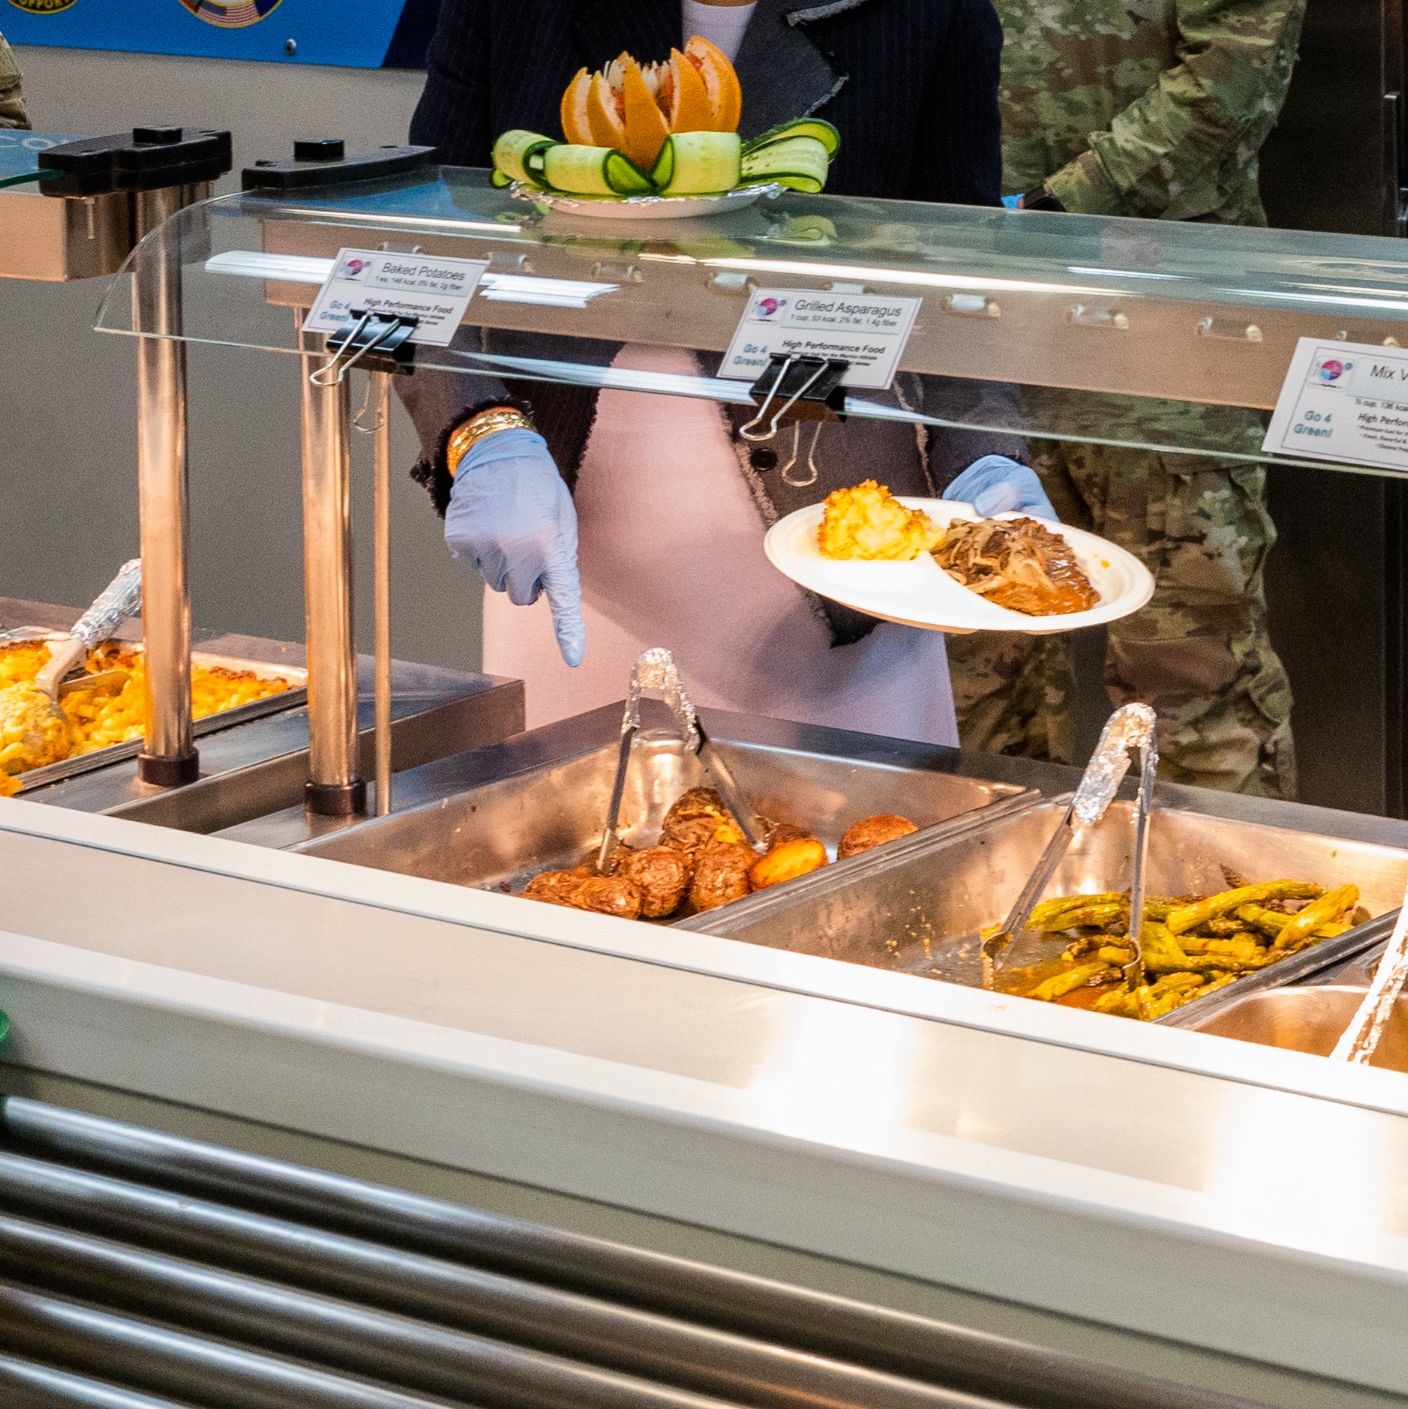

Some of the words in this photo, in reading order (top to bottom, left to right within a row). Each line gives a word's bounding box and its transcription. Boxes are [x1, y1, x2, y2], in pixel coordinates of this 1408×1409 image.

[381, 262, 416, 276] Baked
[417, 265, 466, 281] Potatoes
[329, 300, 343, 309] Go
[343, 302, 351, 310] 4
[364, 297, 382, 308] High
[383, 299, 431, 312] Performance
[432, 303, 453, 315] Food
[794, 299, 835, 312] Grilled
[837, 301, 903, 318] Asparagus
[743, 343, 758, 354] Go
[759, 345, 768, 355] 4
[782, 340, 802, 350] High
[805, 340, 861, 353] Performance
[861, 344, 886, 354] Food
[732, 355, 768, 367] Green!
[1370, 364, 1395, 380] Mix
[1304, 410, 1322, 422] Go
[1323, 412, 1333, 423] 4
[1357, 413, 1378, 424] High
[1293, 423, 1334, 439] Green!
